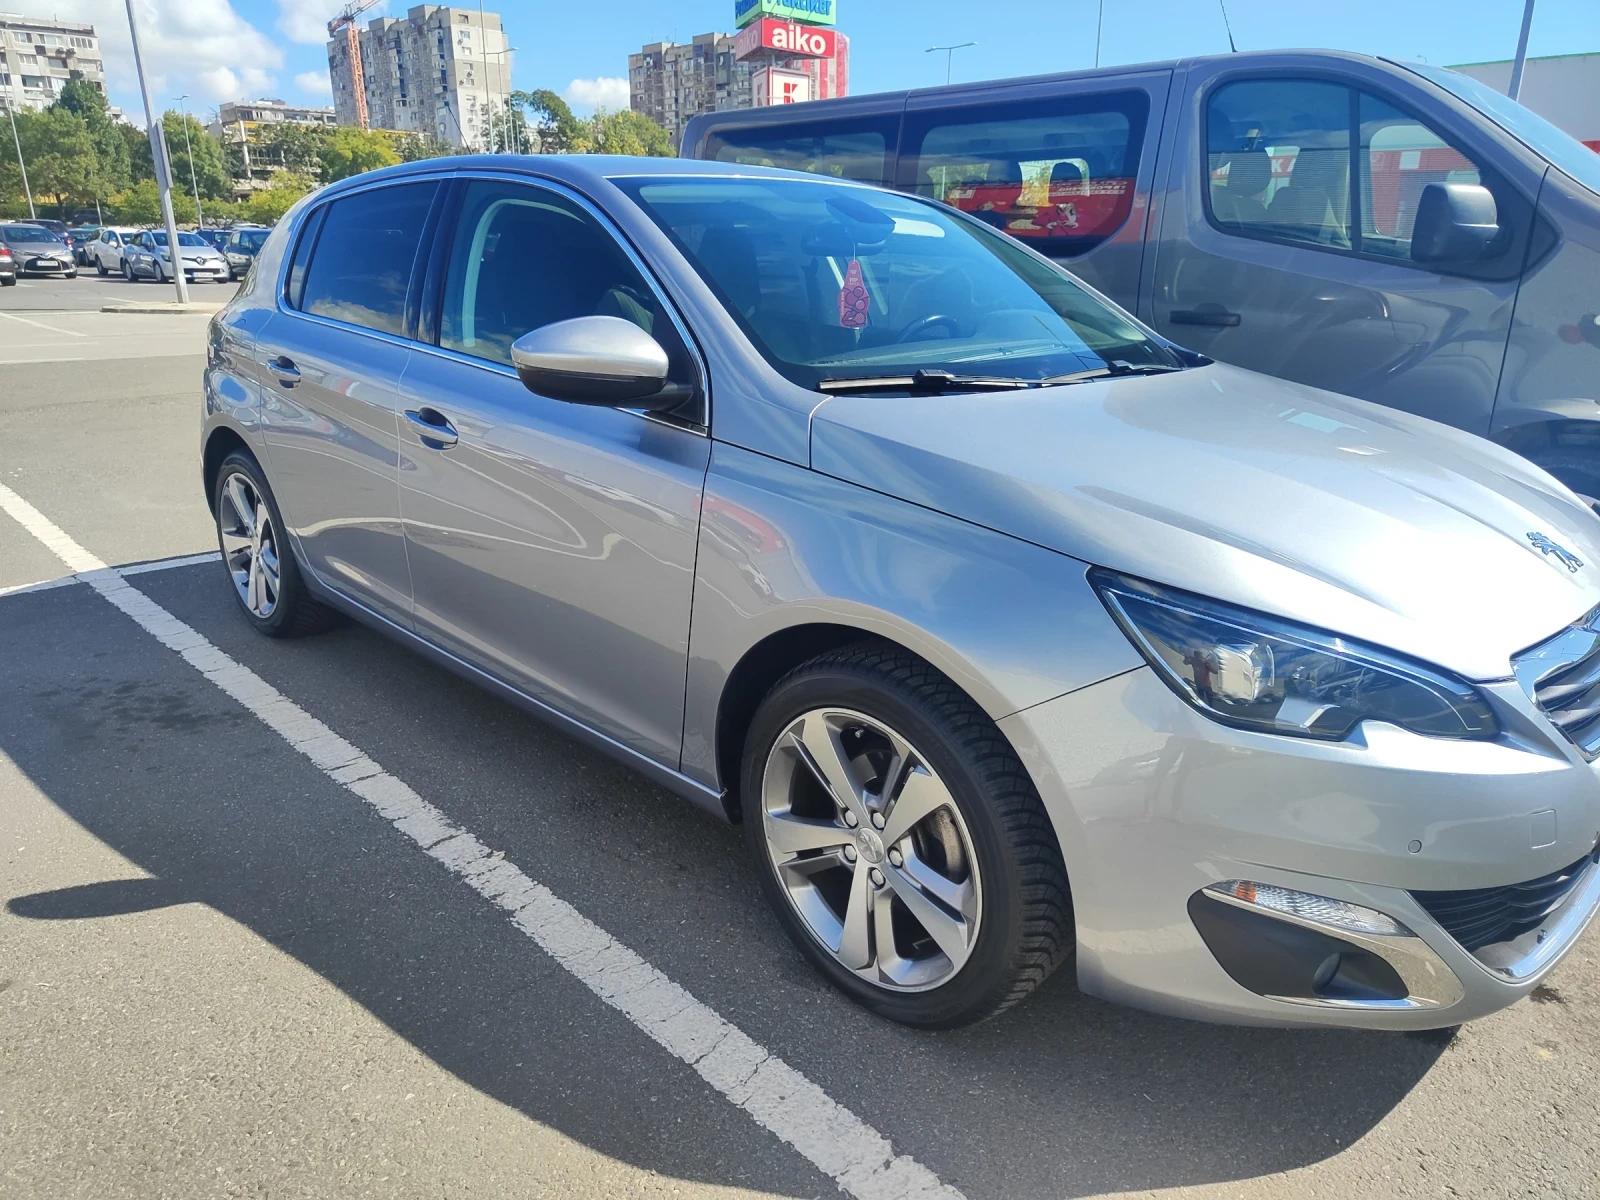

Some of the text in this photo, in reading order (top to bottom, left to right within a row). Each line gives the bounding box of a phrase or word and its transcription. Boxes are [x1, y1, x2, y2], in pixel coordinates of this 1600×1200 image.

[767, 0, 832, 15] aktiker
[771, 24, 827, 54] aiko
[784, 82, 799, 104] K
